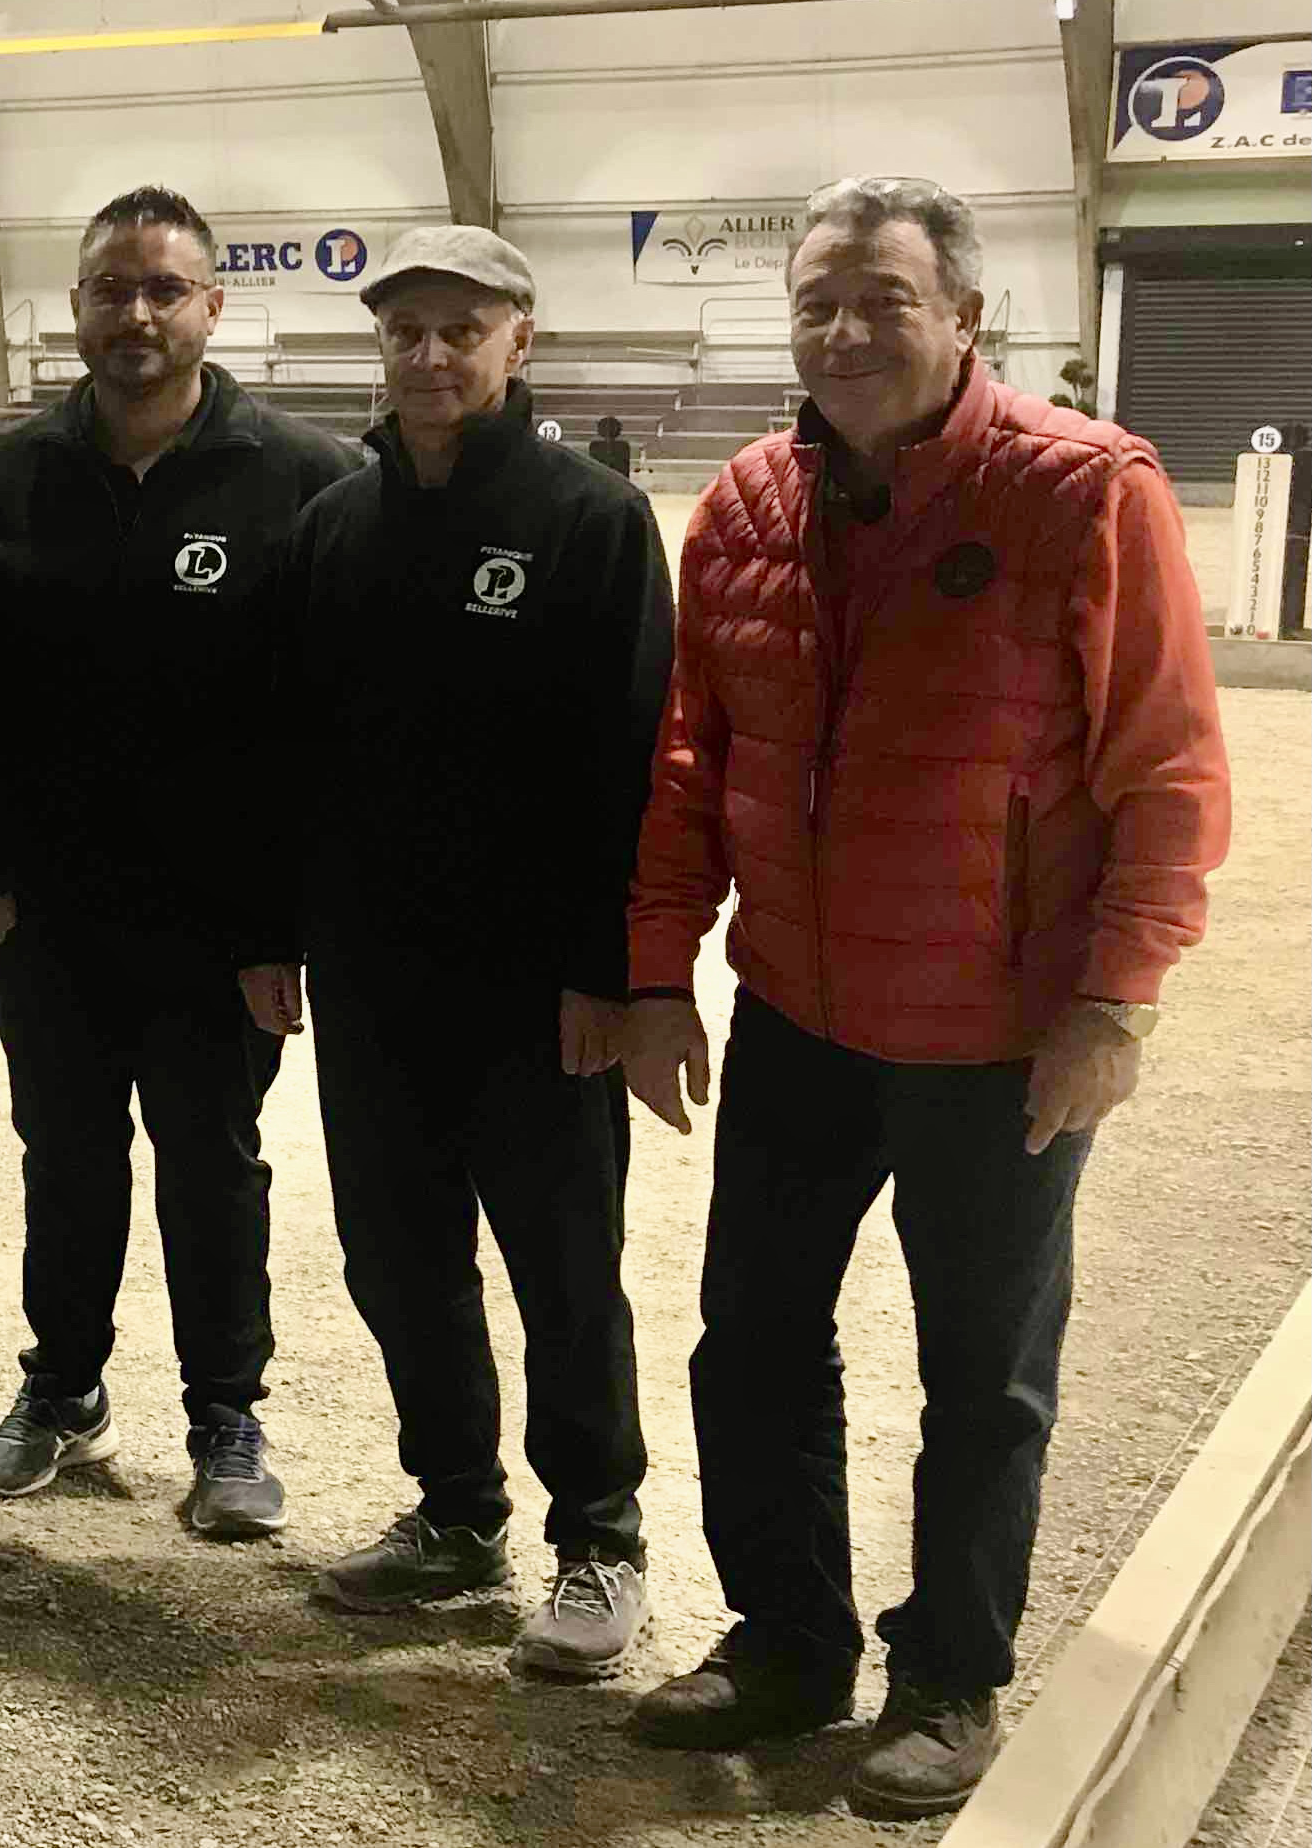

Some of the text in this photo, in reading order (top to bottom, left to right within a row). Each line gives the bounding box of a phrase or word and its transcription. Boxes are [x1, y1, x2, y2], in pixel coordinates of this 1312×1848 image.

[719, 216, 795, 232] ALLIER
[735, 256, 749, 268] Le
[1258, 432, 1276, 448] 15
[1257, 457, 1271, 469] 13
[1257, 470, 1270, 482] 12
[1254, 496, 1268, 508] 10
[1256, 508, 1265, 521] 9
[1254, 522, 1263, 533] 8
